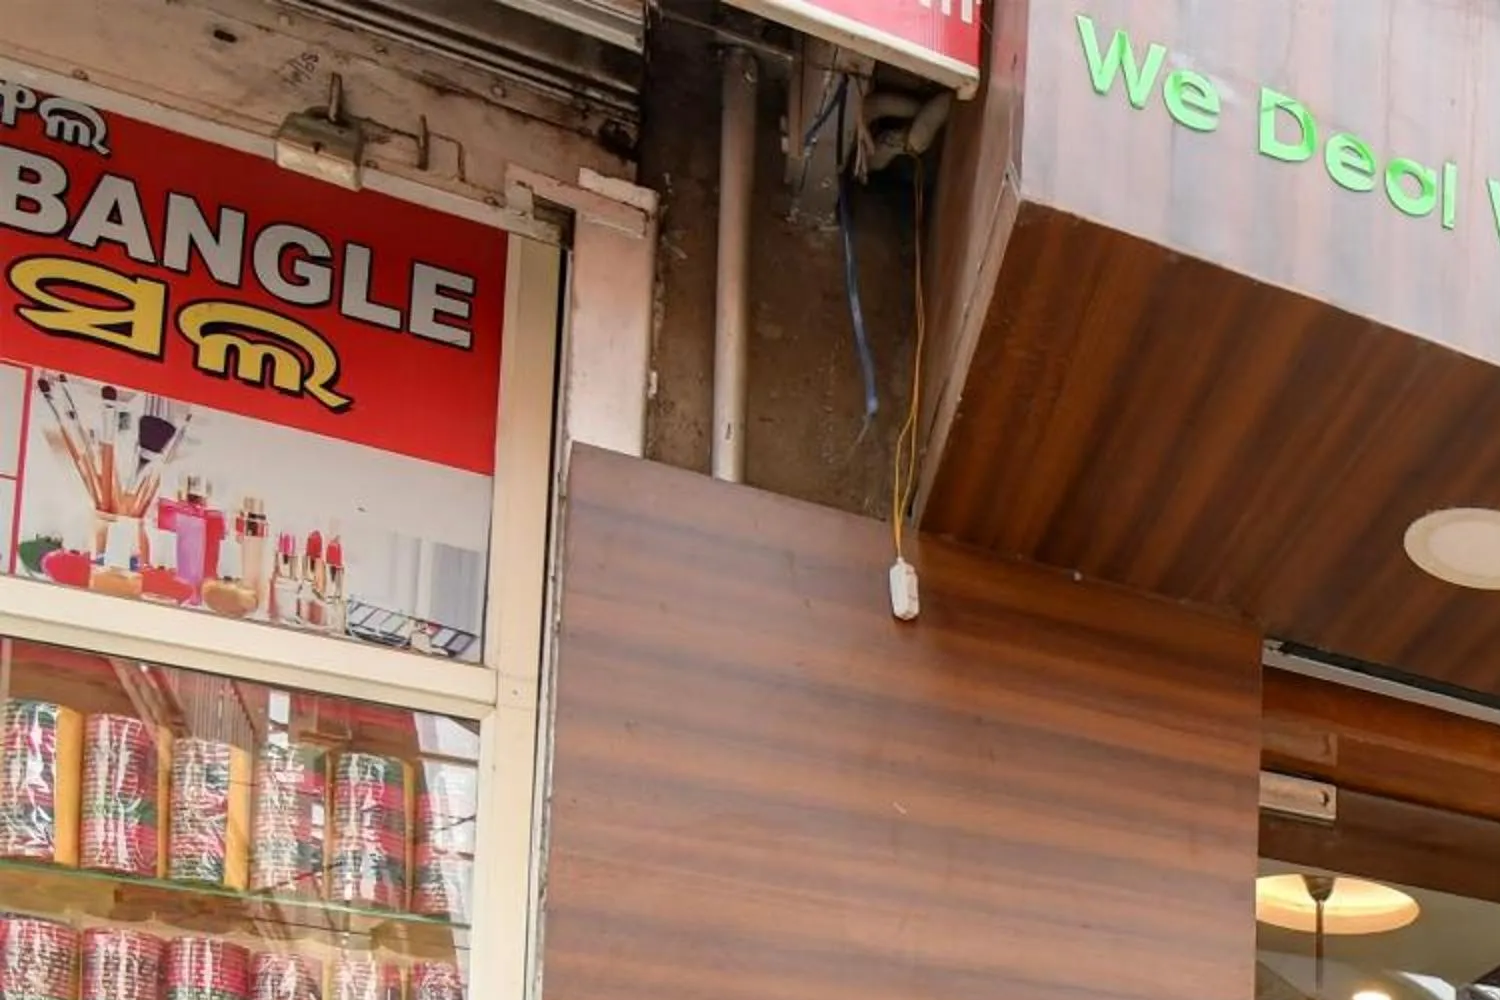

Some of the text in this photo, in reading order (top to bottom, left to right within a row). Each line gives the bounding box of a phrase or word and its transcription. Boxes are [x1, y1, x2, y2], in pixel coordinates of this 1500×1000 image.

[1074, 14, 1222, 133] We
[1257, 86, 1458, 231] Deal
[0, 144, 477, 350] BANGLE
